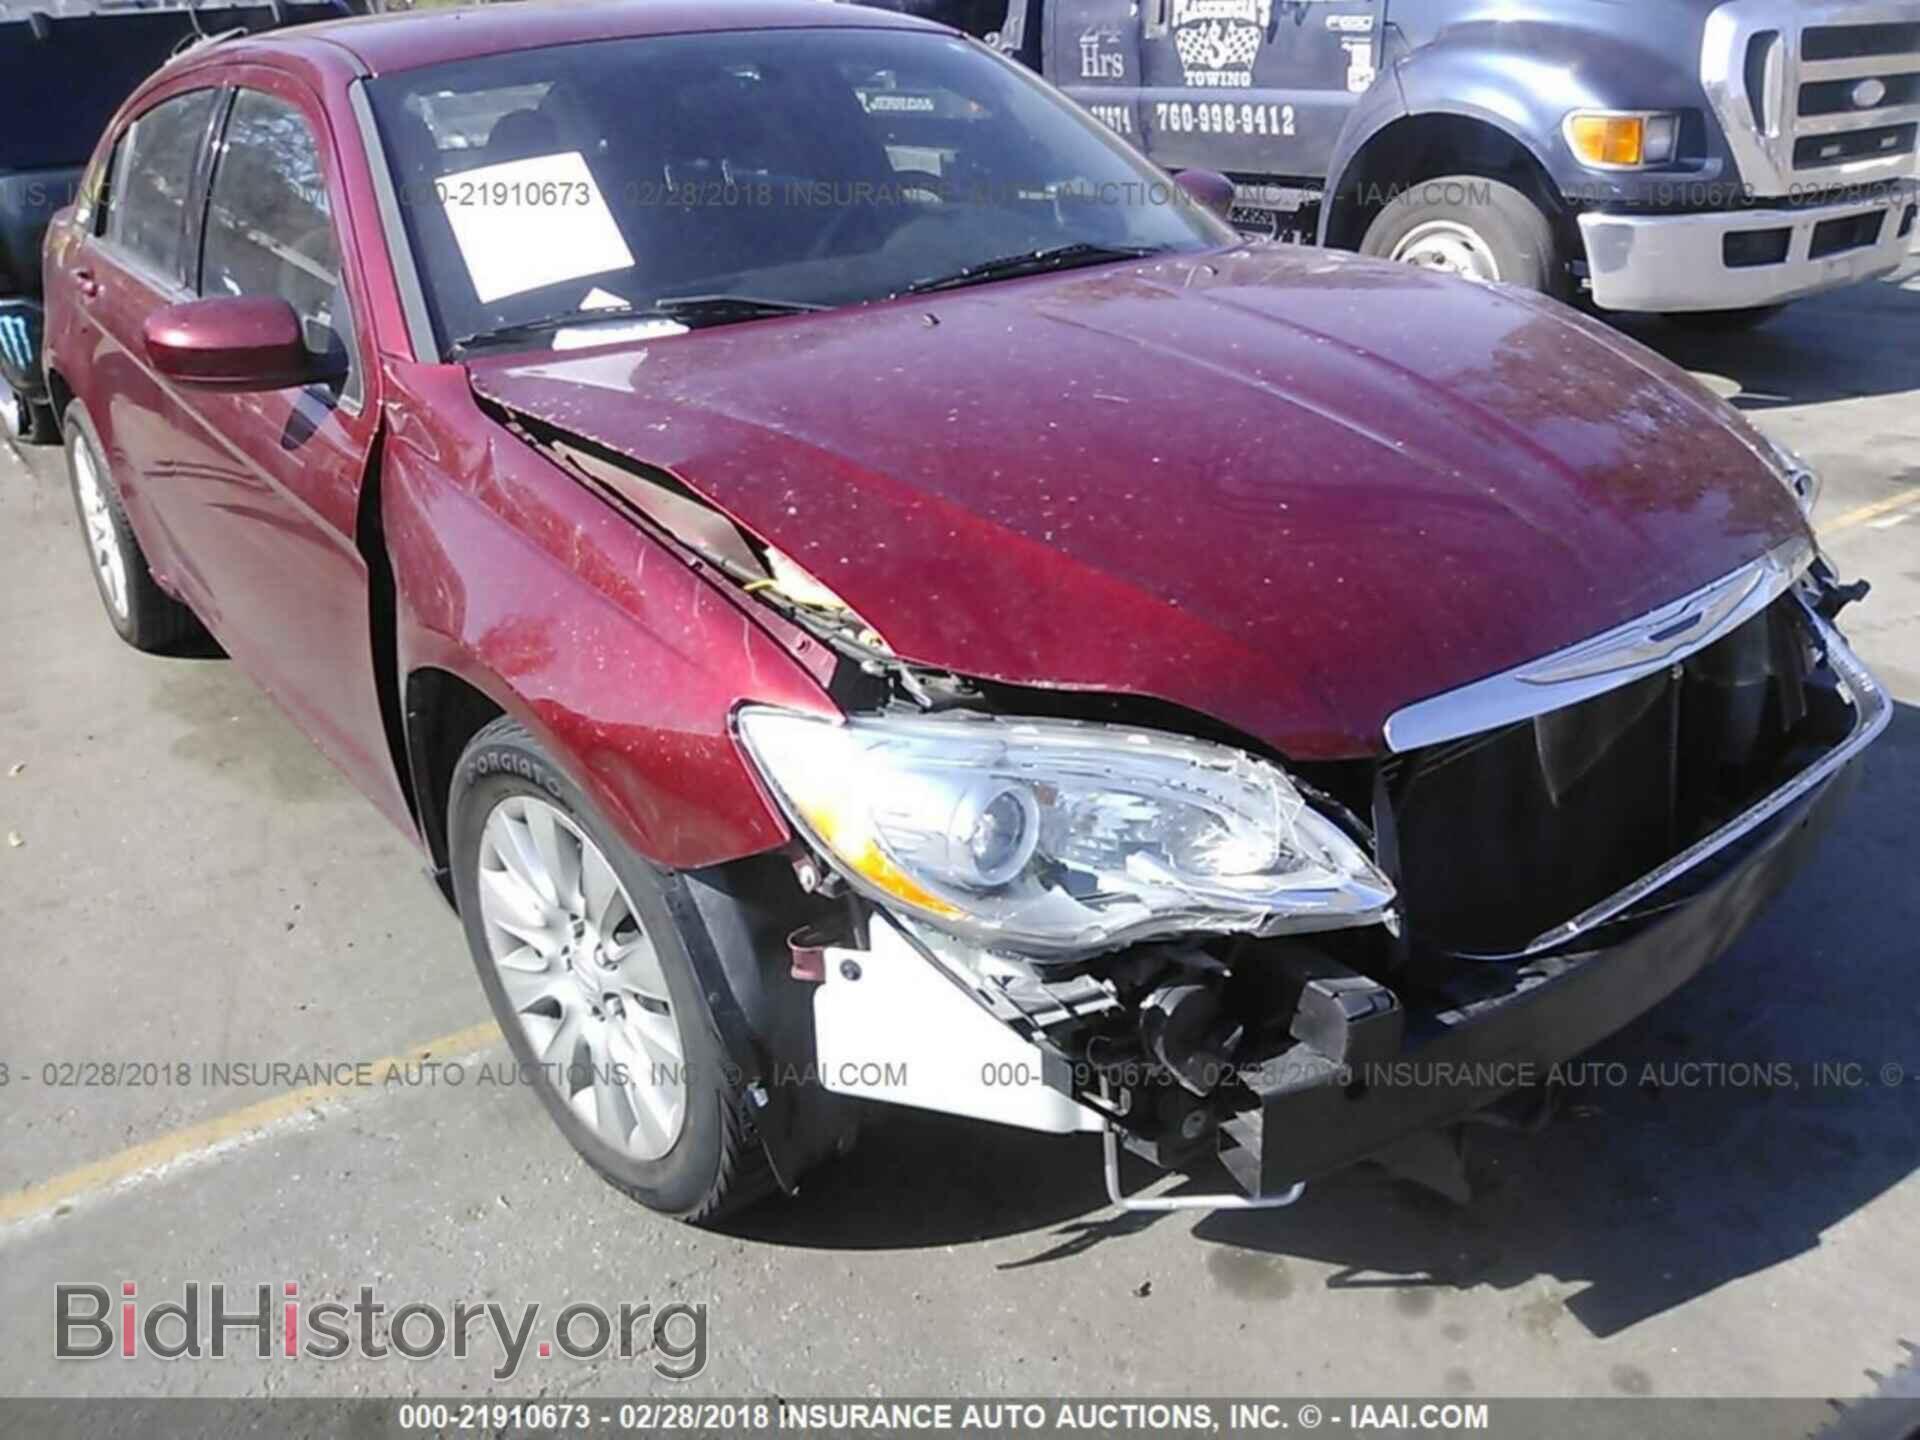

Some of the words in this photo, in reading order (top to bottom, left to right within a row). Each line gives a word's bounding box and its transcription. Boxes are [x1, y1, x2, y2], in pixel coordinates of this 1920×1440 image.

[1080, 43, 1124, 78] Hrs
[1185, 71, 1251, 86] TOWING
[1157, 103, 1295, 135] 760-998-9412
[465, 752, 561, 798] FORGIATO
